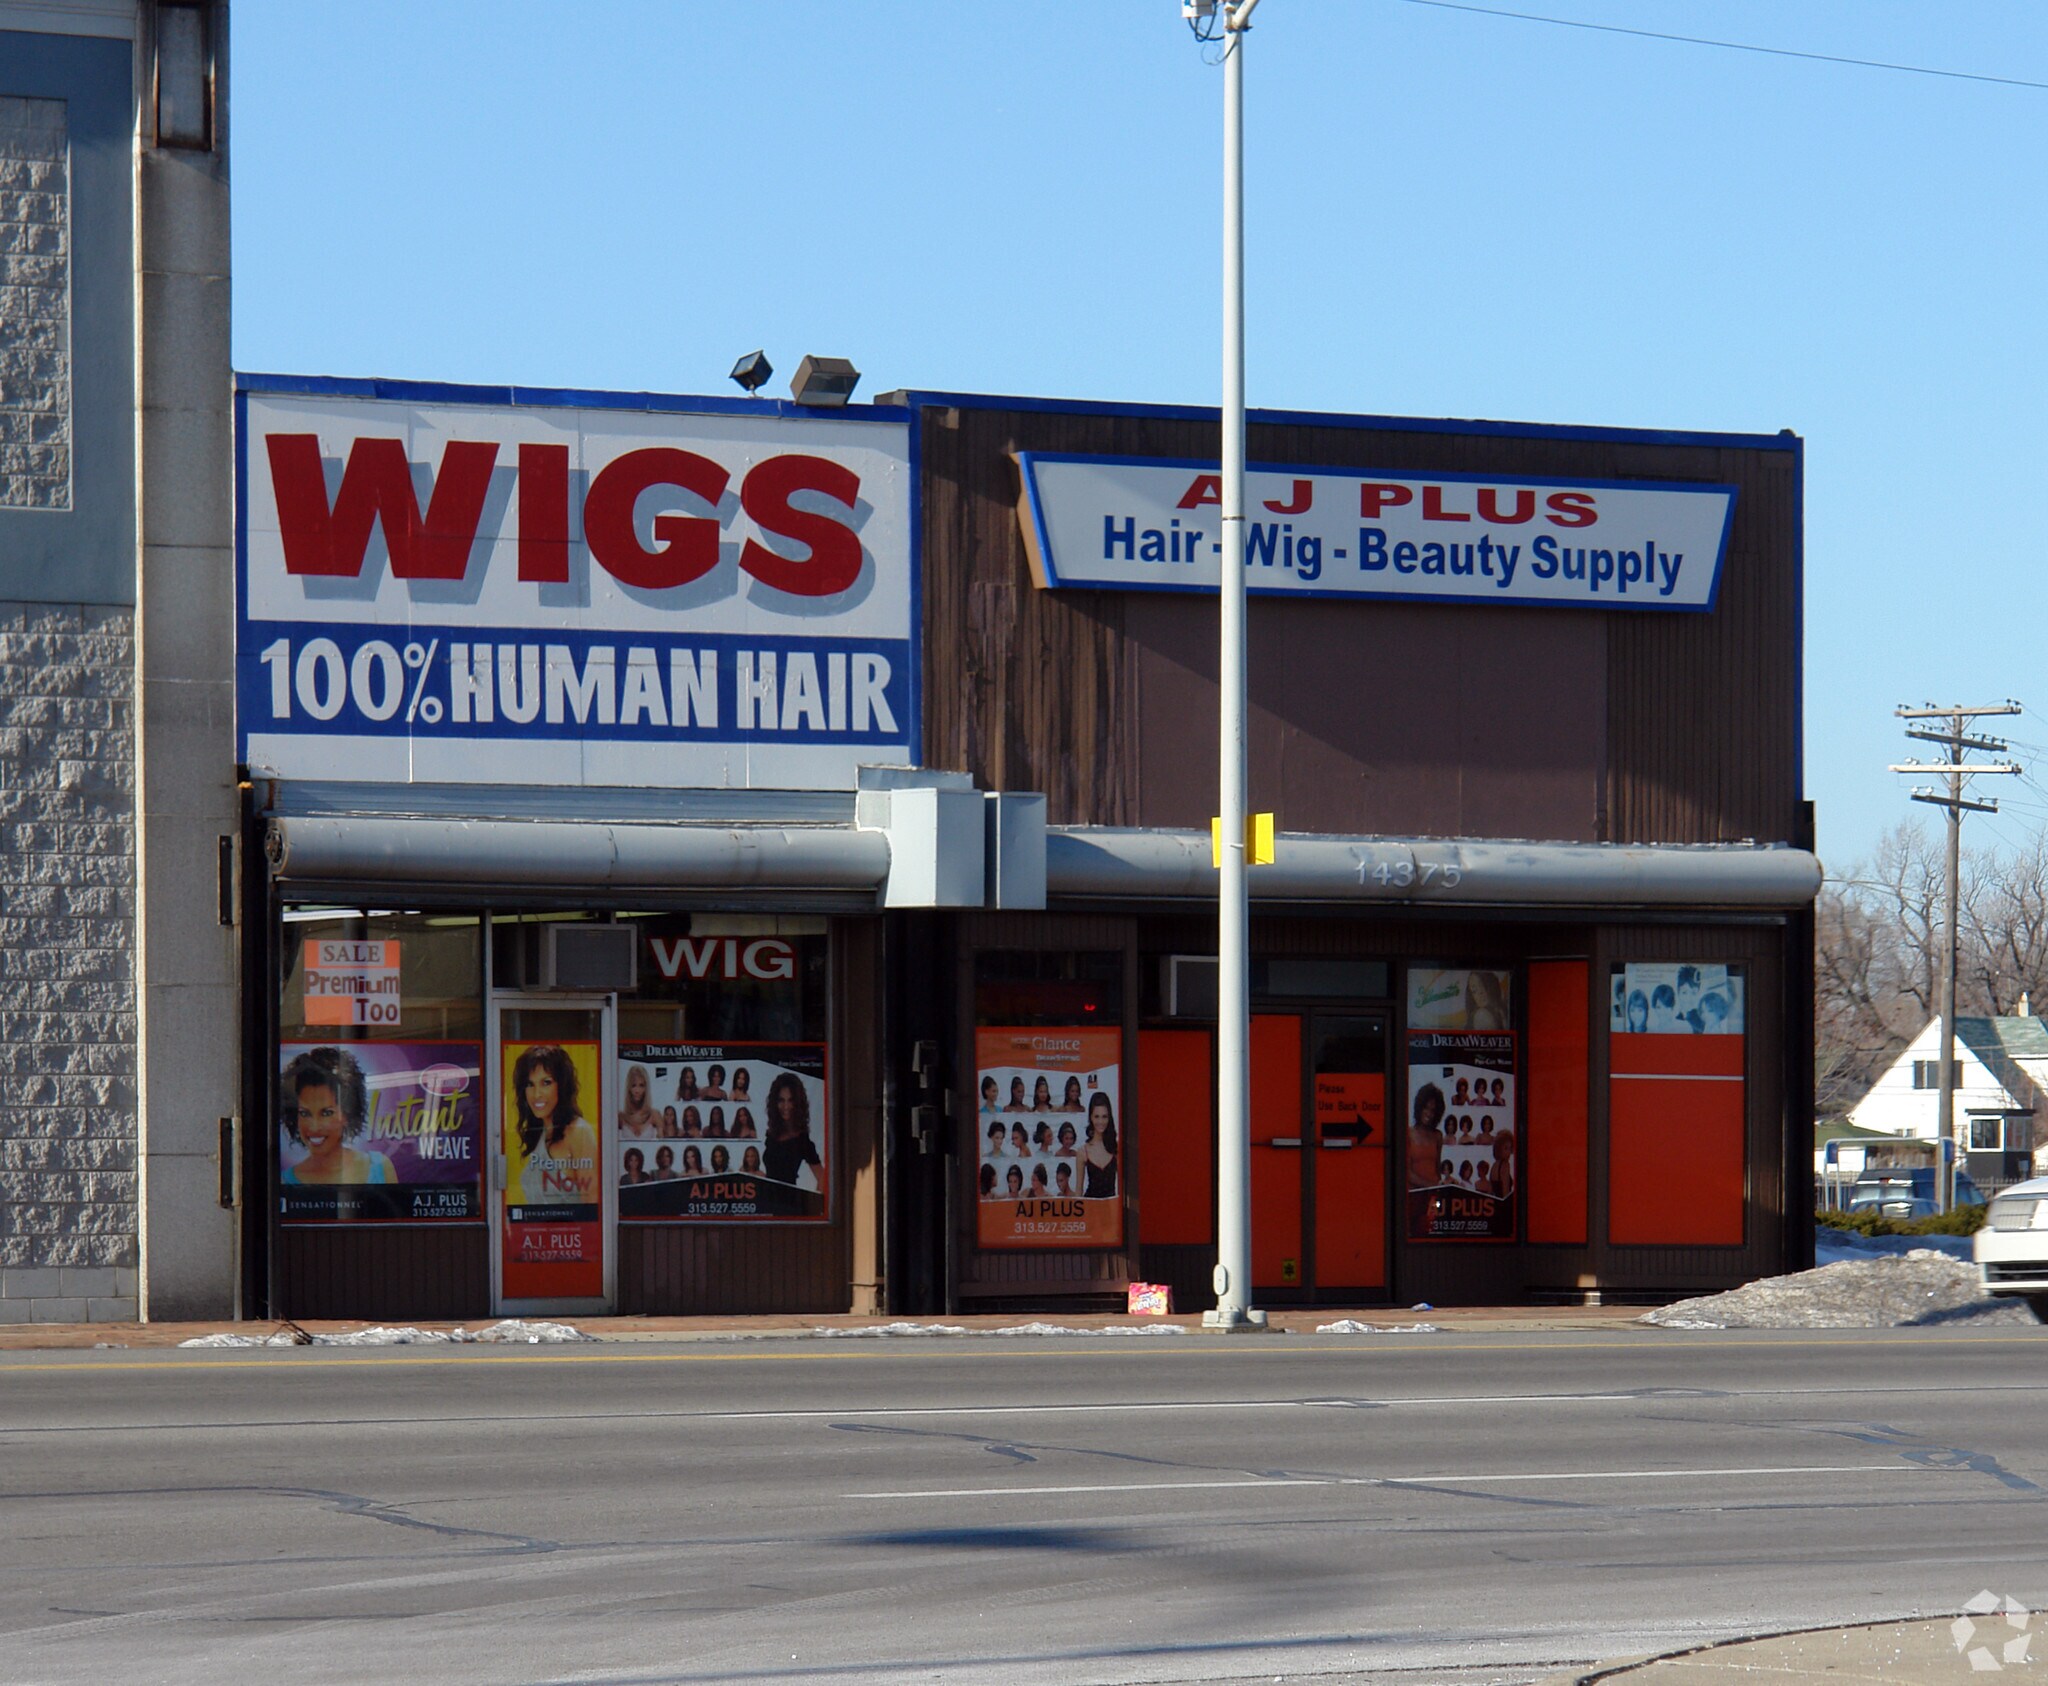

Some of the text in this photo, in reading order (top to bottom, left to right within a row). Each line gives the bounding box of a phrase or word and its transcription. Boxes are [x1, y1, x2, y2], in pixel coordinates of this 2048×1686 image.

[265, 433, 863, 596] WIGS
[1360, 483, 1599, 528] PLUS
[1104, 515, 1204, 563] Hair
[1246, 522, 1322, 580] Wig
[1361, 527, 1521, 587] Beauty
[1532, 535, 1684, 596] Supply
[260, 637, 899, 733] 100% HUMAN HAIR
[1355, 860, 1462, 888] 14375
[323, 944, 380, 962] SALE
[650, 938, 795, 979] WIG
[304, 970, 400, 994] Premium
[356, 998, 398, 1022] Too
[1031, 1036, 1081, 1050] Glance
[367, 1089, 470, 1142] Instant
[419, 1136, 471, 1160] WEAVE
[530, 1154, 593, 1170] Premium
[542, 1170, 592, 1192] Now
[714, 1183, 757, 1200] PLUS
[439, 1194, 468, 1207] PLUS
[688, 1203, 757, 1214] 313.527.5559
[1040, 1200, 1085, 1218] PLUS
[1451, 1199, 1495, 1217] PLUS
[1014, 1222, 1086, 1233] 313.527.5559
[551, 1233, 582, 1249] PLUS
